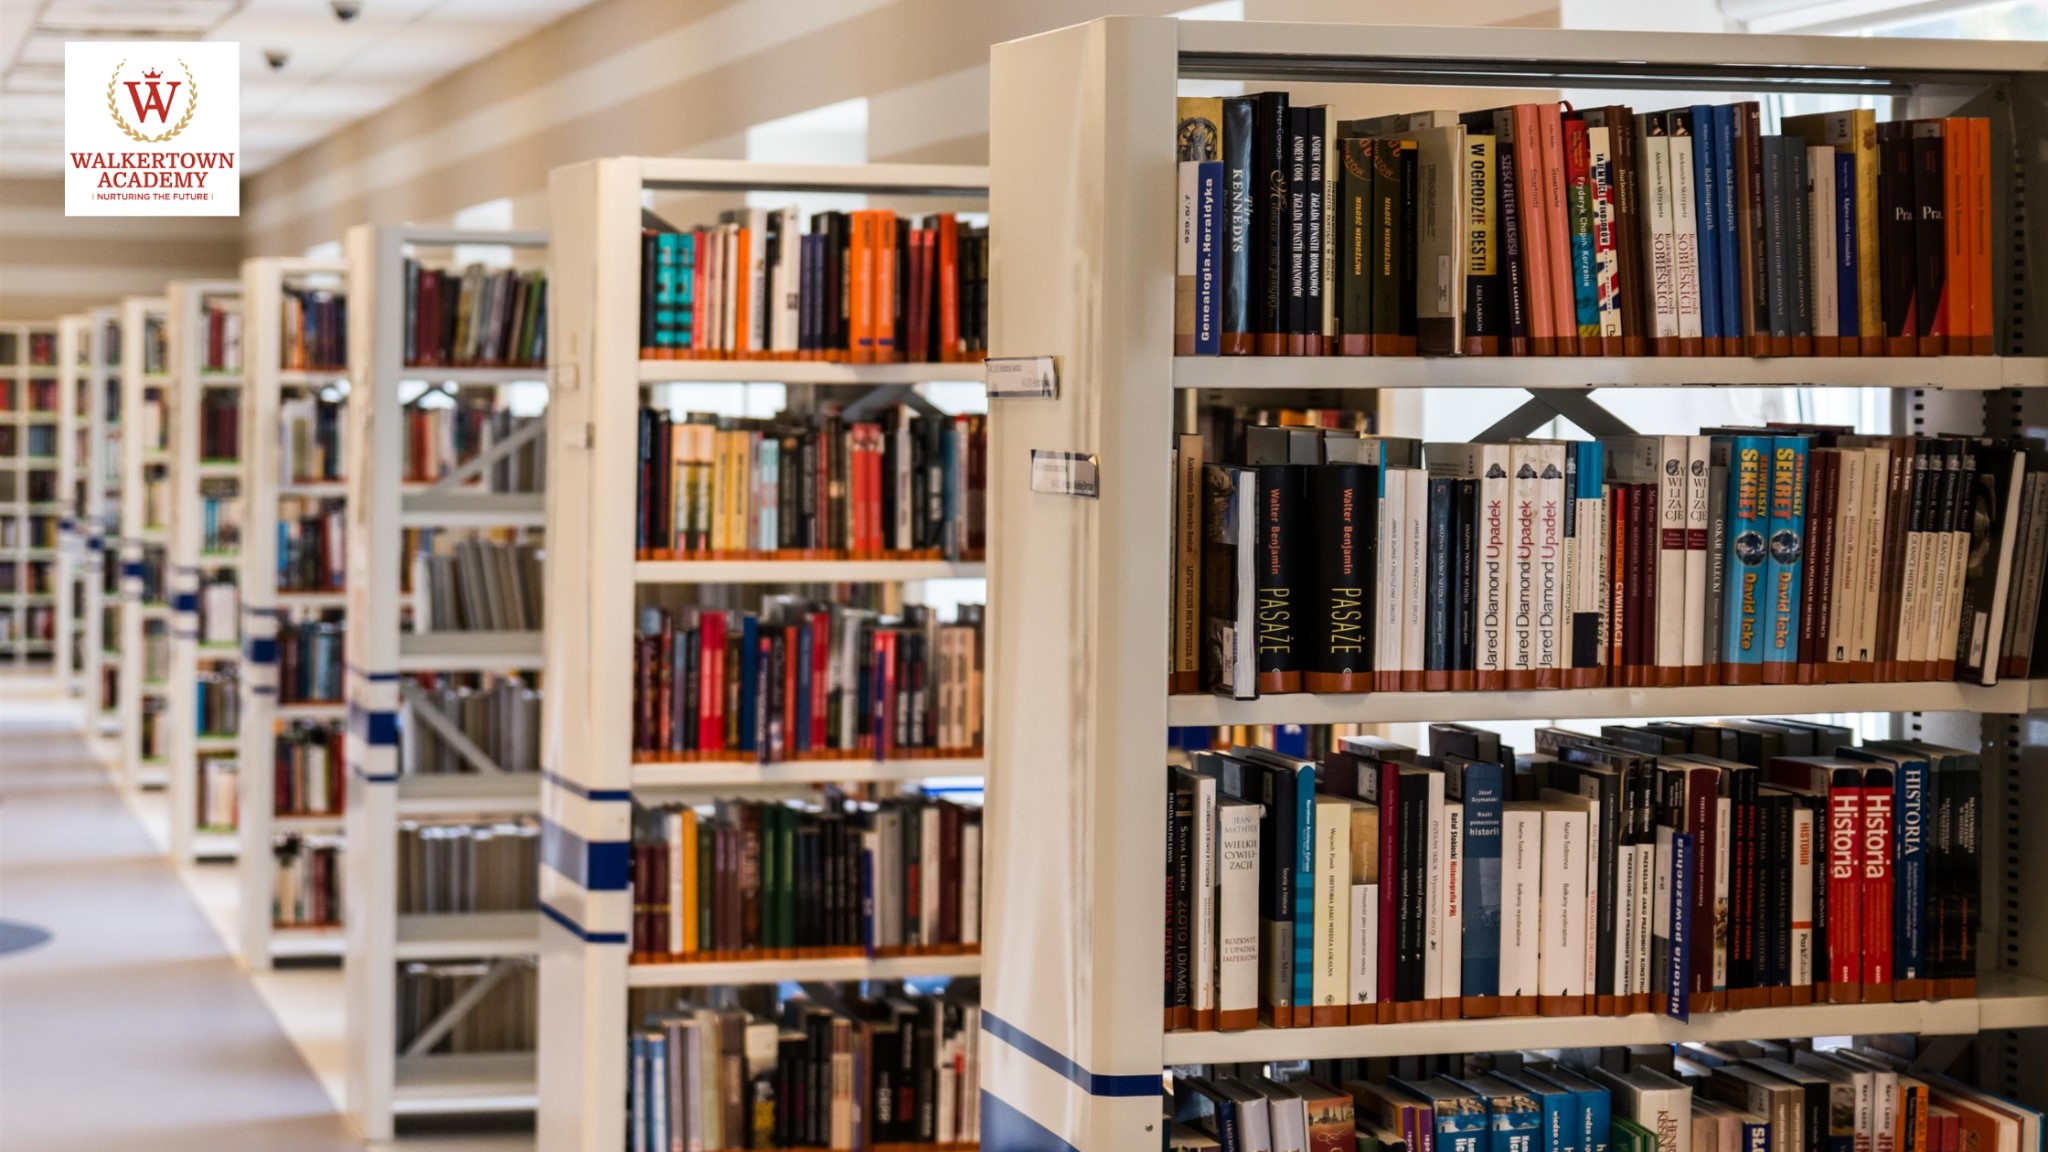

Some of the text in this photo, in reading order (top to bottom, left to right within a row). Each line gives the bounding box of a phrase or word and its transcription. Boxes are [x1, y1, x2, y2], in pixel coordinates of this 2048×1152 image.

[1294, 135, 1303, 181] ANDREW COOK
[1312, 135, 1320, 181] ANDREW COOK
[1530, 169, 1540, 208] Stuartowie
[1551, 168, 1561, 208] Stuartowie
[1232, 169, 1243, 252] KENNEDYS
[1471, 144, 1486, 272] W OGRODZIE BESTII
[1577, 176, 1588, 214] Fryderyk
[1596, 153, 1609, 244] TAJEMNICE WINDSORÓW
[1619, 169, 1628, 214] Burbonowie
[1704, 184, 1714, 230] Bonapartych
[1726, 185, 1735, 231] Bonapartych
[1201, 179, 1213, 341] Genealogia.Heraldyka
[1293, 193, 1304, 297] ZAGŁADA DYNASTII ROMANOWÓW
[1310, 193, 1321, 297] ZAGŁADA DYNASTII ROMANOWÓW
[1355, 197, 1363, 276] MIŁOŚĆ NIEMOŻLIWA
[1384, 197, 1392, 276] MIŁOŚĆ NIEMOŻLIWA
[1506, 216, 1518, 255] LUKSUSU
[1578, 217, 1589, 248] Chopin.
[1582, 250, 1591, 287] Korzenie
[1654, 233, 1668, 315] SOBIESKICH
[1677, 233, 1691, 315] SOBIESKICH
[1739, 449, 1758, 520] SEKRET
[1773, 448, 1794, 520] SEKRET
[1267, 488, 1281, 574] Walter Benjamin
[1340, 488, 1353, 574] Walter Benjamin
[1486, 500, 1504, 559] Upadek
[1518, 501, 1534, 559] Upadek
[1542, 501, 1558, 559] Upadek
[1712, 519, 1723, 592] OSKAR HALECKI
[1847, 516, 1856, 543] Historia
[1872, 518, 1880, 545] Historia
[1922, 534, 1933, 589] OBLICZA HISTORII
[1953, 534, 1965, 588] OBLICZA HISTORII
[1905, 534, 1918, 602] GRANICE HISTORII
[1935, 534, 1948, 602] GRANICE HISTORII
[1259, 588, 1294, 654] PASAŻE
[1331, 588, 1365, 654] PASAŻE
[1484, 562, 1500, 671] Jared Diamond
[1516, 562, 1531, 671] Jared Diamond
[1540, 562, 1555, 669] Jared Diamond
[1614, 582, 1623, 648] CYWILIZACJE
[1741, 573, 1756, 650] David Icke
[1775, 572, 1792, 648] David Icke
[1224, 839, 1258, 849] WIELKIE
[1450, 813, 1458, 859] Rafał Stobiecki
[1470, 828, 1499, 836] historii
[1800, 822, 1809, 865] HISTORIA
[1833, 795, 1860, 879] Historia
[1865, 795, 1890, 878] Historia
[1905, 770, 1921, 855] HISTORIA
[1180, 826, 1188, 891] SILVIA LIEBRICH
[1224, 851, 1258, 860] CYWILI-
[1229, 861, 1253, 870] ZACJE
[1178, 900, 1187, 941] ZŁOTO
[1449, 861, 1457, 917] Historiografia PRL
[1515, 883, 1523, 908] Bałkany
[1561, 883, 1570, 947] Bałkany wyobrażone
[1671, 838, 1685, 1014] Historia powszechna
